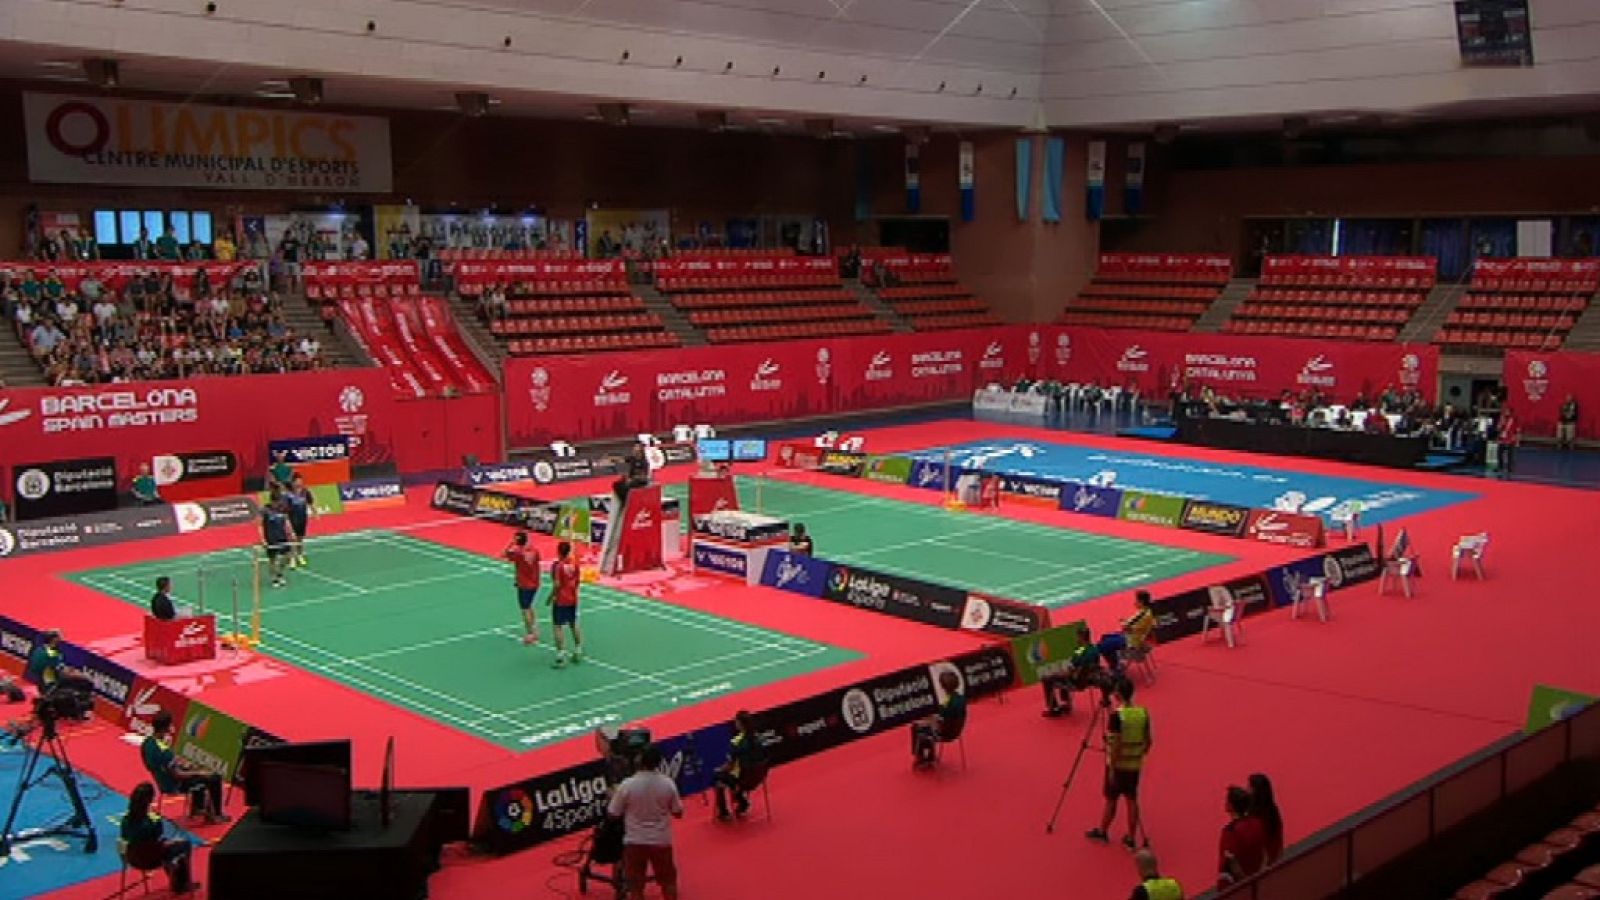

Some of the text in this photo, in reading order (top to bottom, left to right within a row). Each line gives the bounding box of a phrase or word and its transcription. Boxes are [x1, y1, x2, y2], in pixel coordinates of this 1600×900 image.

[45, 101, 359, 160] OLIMPICS
[83, 151, 360, 175] CENTRE MUNICIPAL D'ESPORTS
[204, 173, 249, 184] VALL
[41, 388, 197, 415] BARCELONA
[43, 408, 198, 432] SPAIN MASTERS
[291, 443, 346, 459] VICTOR
[534, 775, 607, 813] LaLiga
